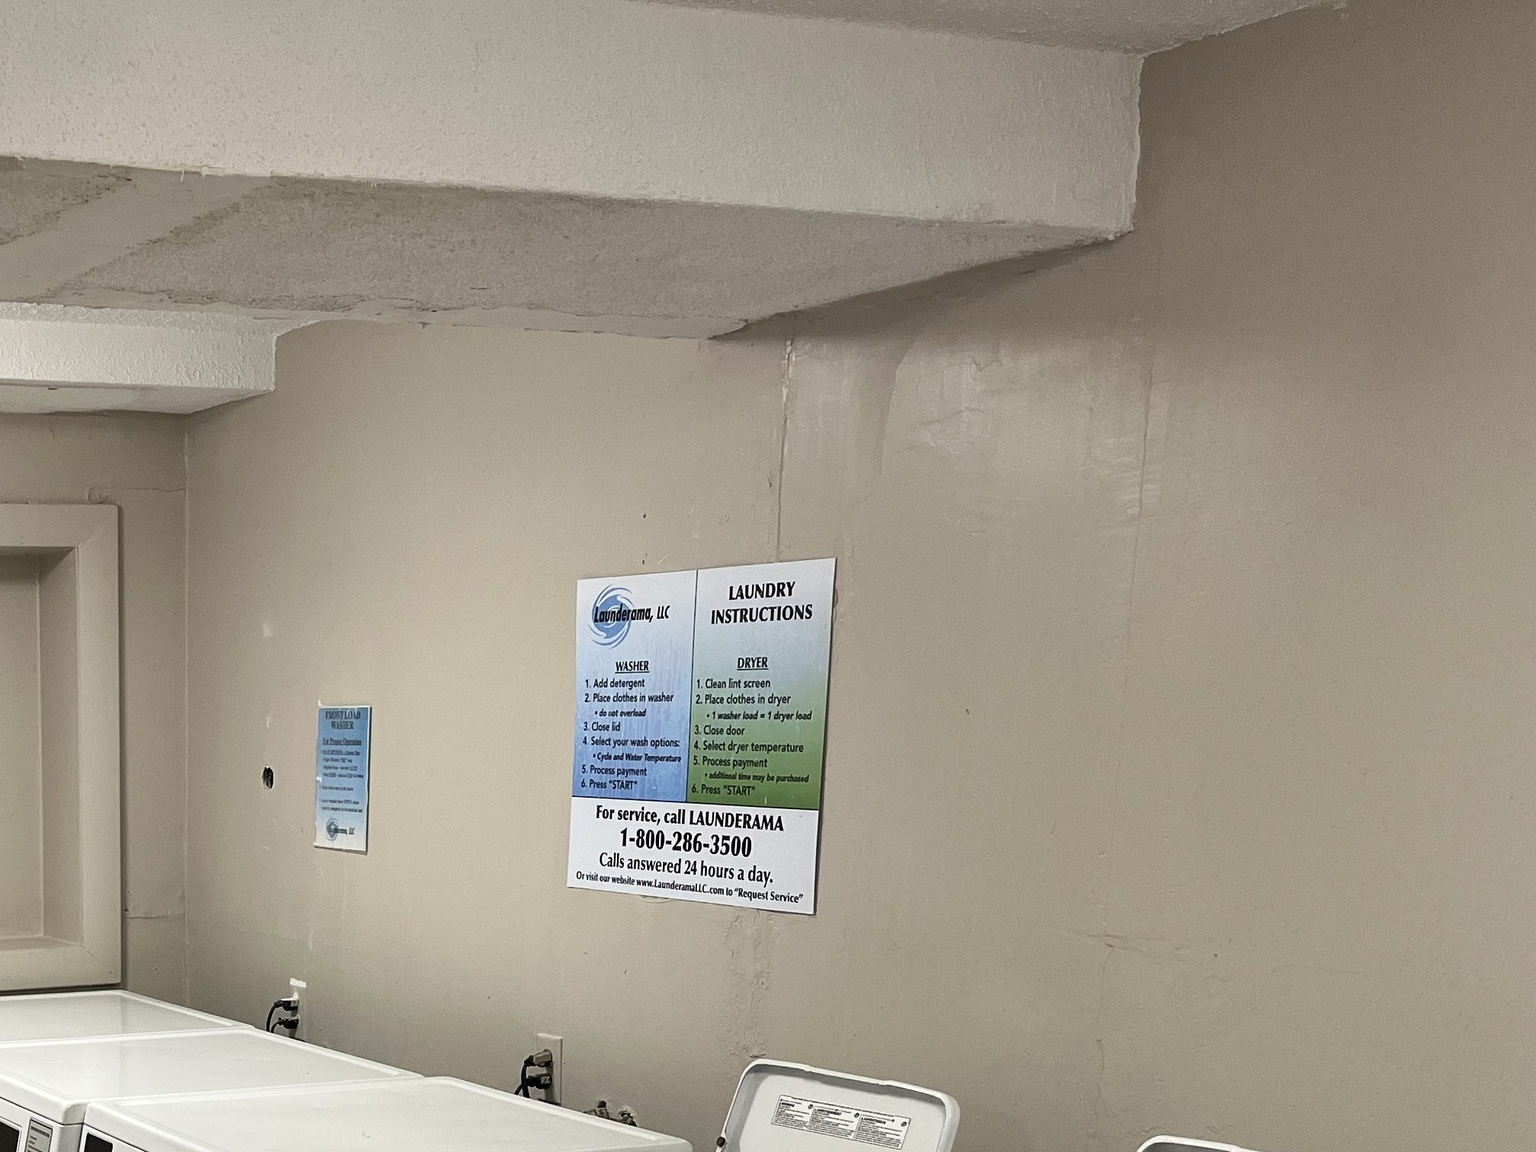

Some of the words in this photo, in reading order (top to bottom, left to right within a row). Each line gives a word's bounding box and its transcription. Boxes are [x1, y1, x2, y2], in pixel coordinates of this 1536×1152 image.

[729, 581, 796, 600] LAUNDRY
[594, 603, 654, 623] Launderama,
[657, 605, 670, 619] LLC
[711, 604, 813, 624] INSTRUCTIONS
[615, 660, 650, 674] WASHER
[737, 657, 769, 670] DRYER
[593, 678, 608, 688] Add
[610, 679, 645, 690] detergent
[697, 679, 703, 689] 1.
[705, 679, 726, 688] Clean
[728, 678, 741, 688] lint
[743, 680, 771, 688] screen
[585, 693, 591, 703] 2.
[593, 693, 611, 702] Place
[612, 693, 637, 702] clothes
[639, 693, 646, 702] in
[648, 692, 674, 702] washer
[696, 694, 702, 704] 2.
[705, 694, 724, 704] Place
[727, 693, 755, 704] clothes
[758, 694, 765, 703] in
[768, 693, 791, 707] dryer
[620, 709, 646, 717] overload
[712, 711, 716, 719] 1
[717, 711, 741, 719] washer
[743, 711, 758, 719] load
[768, 711, 771, 719] 1
[774, 711, 794, 722] dryer
[796, 711, 812, 720] load
[584, 722, 590, 731] 3.
[592, 722, 610, 731] Close
[612, 722, 620, 731] lid
[694, 725, 701, 735] 3.
[704, 725, 724, 735] Close
[726, 725, 745, 735] door
[583, 736, 589, 745] 4.
[591, 736, 611, 746] Select
[613, 739, 628, 748] your
[631, 738, 648, 746] wash
[650, 738, 680, 749] options:
[694, 741, 700, 750] 4.
[703, 741, 726, 751] Select
[728, 741, 751, 754] dryer
[751, 743, 804, 754] temperature
[597, 752, 612, 762] Cycle
[625, 753, 643, 761] Water
[644, 753, 681, 763] Temperature
[693, 756, 700, 765] 5.
[702, 756, 730, 766] Process
[733, 759, 768, 769] payment
[582, 765, 588, 774] 5.
[590, 765, 615, 775] Process
[617, 767, 647, 778] payment
[709, 772, 737, 780] additional
[752, 775, 765, 783] may
[766, 773, 775, 781] be
[776, 774, 809, 783] purchased
[581, 779, 587, 788] 6.
[589, 779, 607, 789] Press
[609, 780, 637, 790] "START"
[692, 784, 699, 793] 6.
[701, 784, 721, 794] Press
[723, 785, 756, 796] "START"
[596, 804, 615, 820] For
[617, 806, 661, 826] service,
[664, 809, 685, 824] call
[689, 810, 784, 832] LAUNDERAMA
[620, 827, 752, 857] 1-800-286-3500
[599, 852, 624, 869] Calls
[627, 858, 681, 874] answered
[684, 860, 697, 876] 24
[700, 860, 734, 880] hours
[737, 869, 744, 881] a
[748, 865, 773, 888] day.
[576, 871, 585, 880] Or
[586, 873, 599, 881] visit
[599, 875, 610, 883] our
[611, 876, 635, 885] website
[726, 887, 733, 896] to
